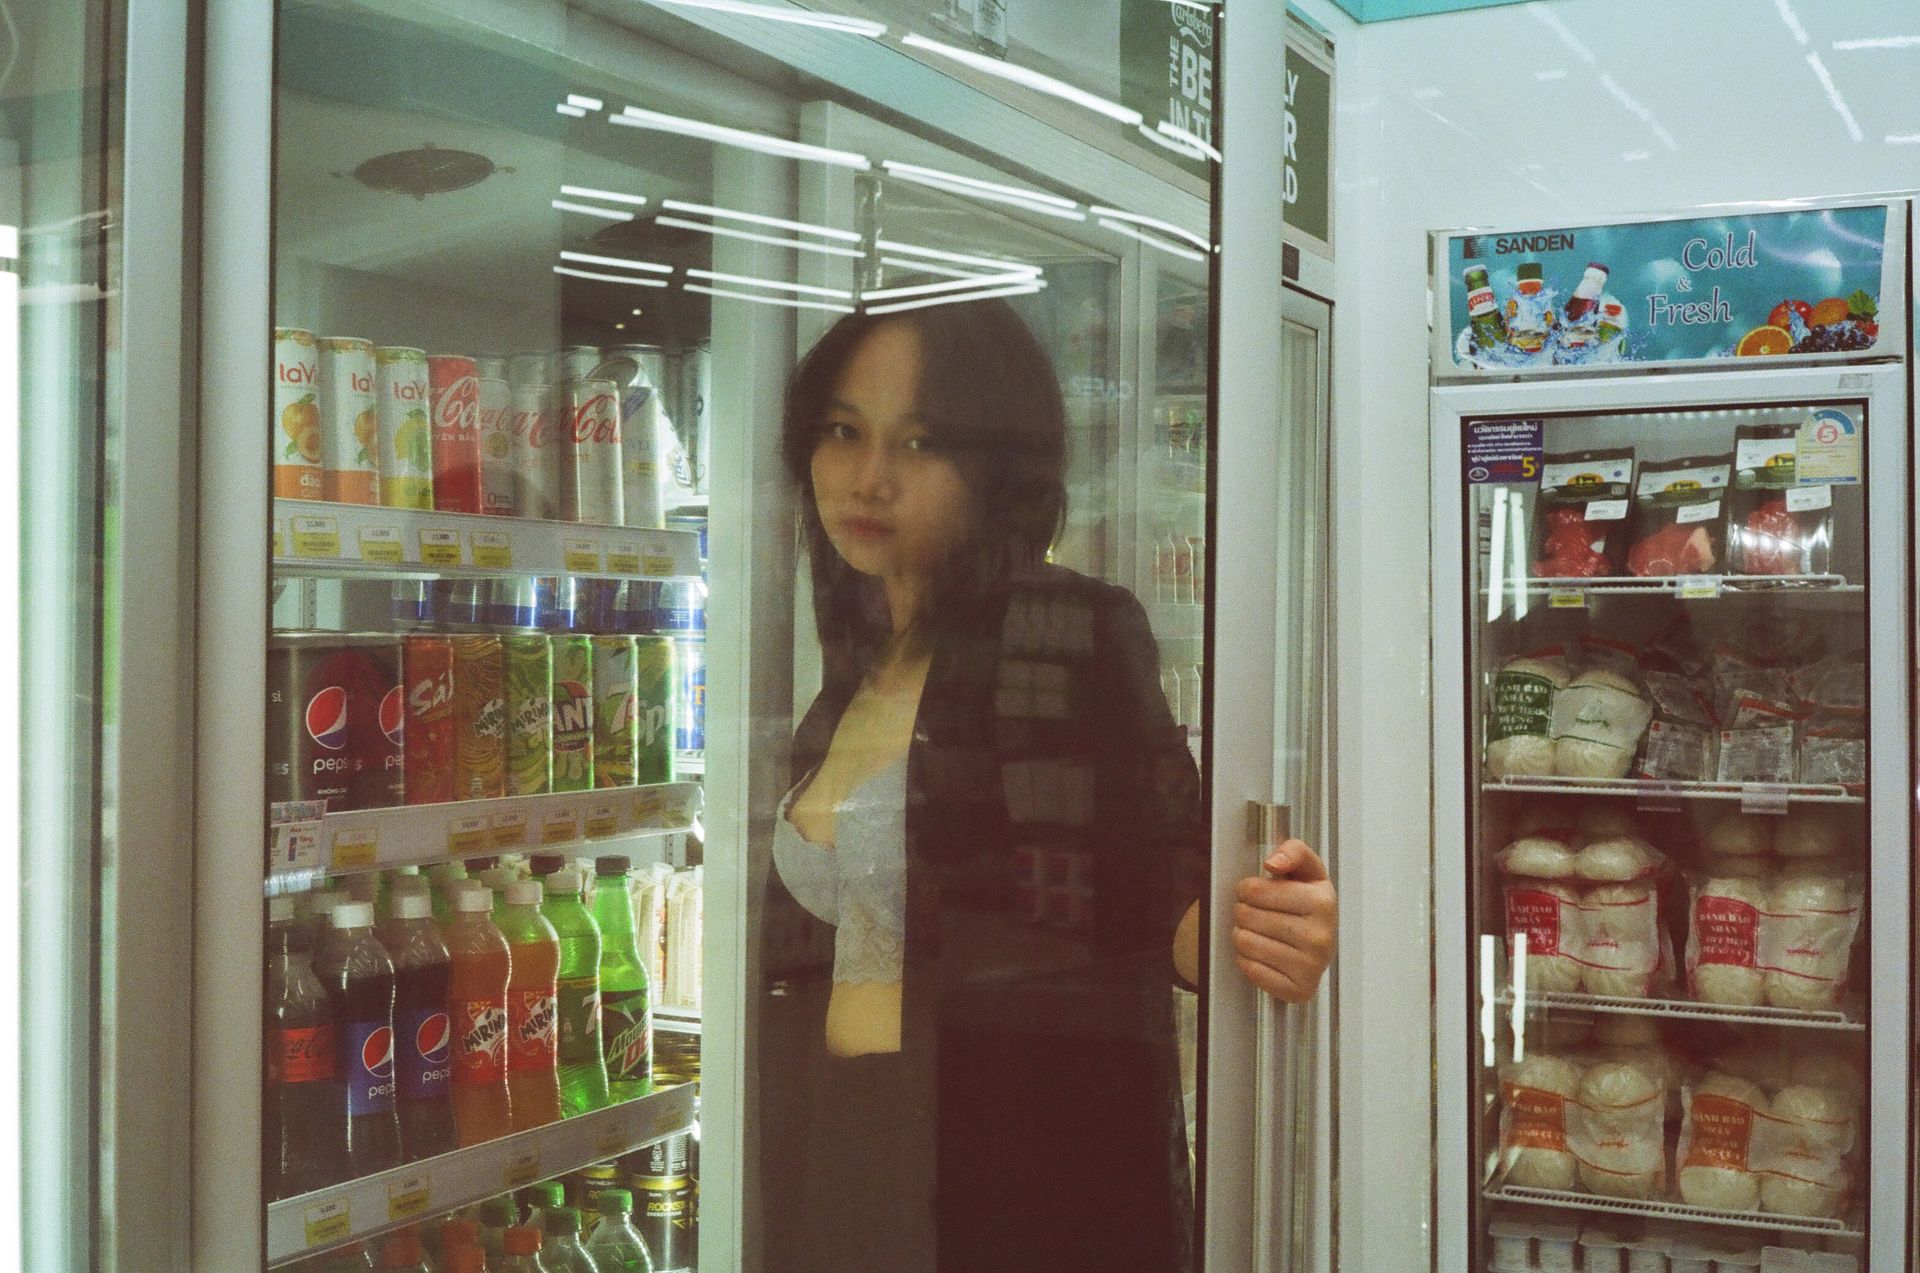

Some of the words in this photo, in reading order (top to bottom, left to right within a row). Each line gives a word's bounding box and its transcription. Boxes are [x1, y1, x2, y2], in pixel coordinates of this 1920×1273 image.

[1169, 35, 1179, 87] THE
[1495, 233, 1575, 255] SANDEN
[1682, 229, 1758, 271] Cold
[1676, 276, 1692, 292] &
[1646, 286, 1734, 326] Fresh
[1522, 456, 1536, 478] 5
